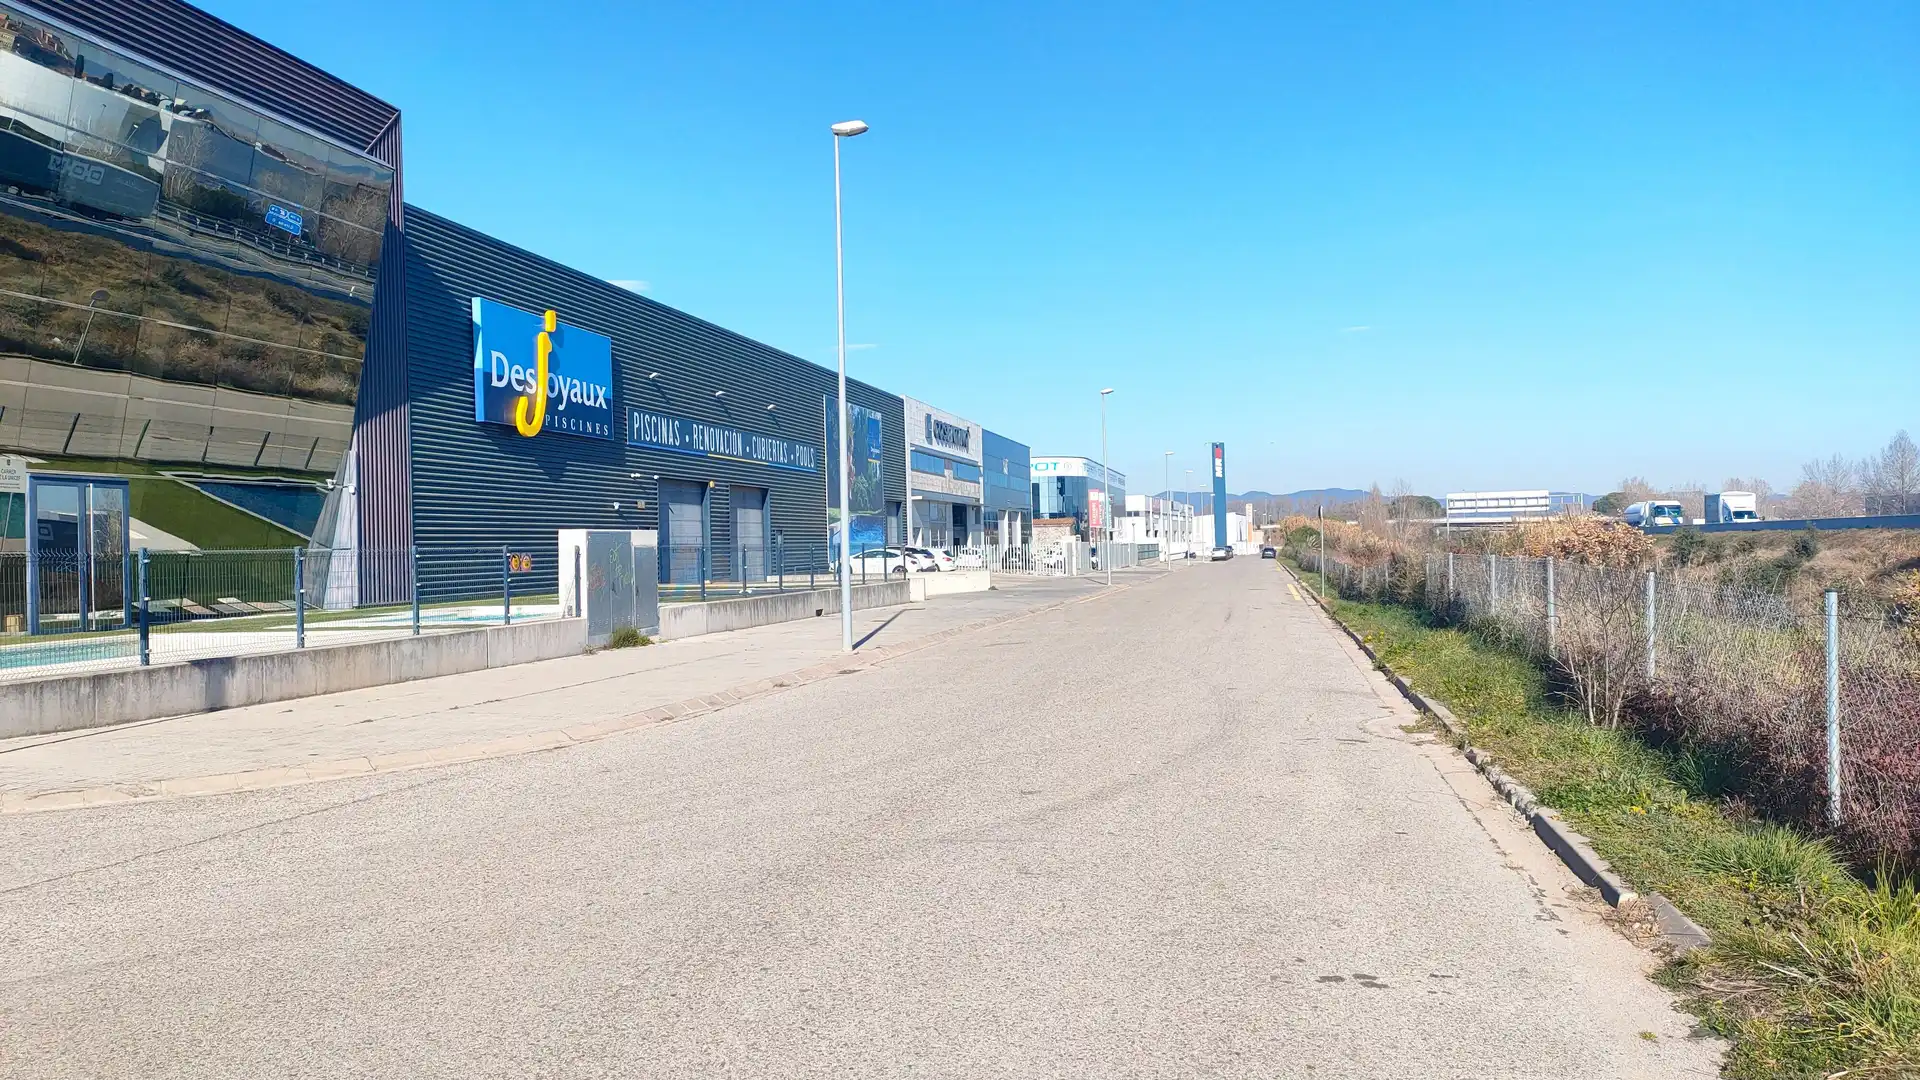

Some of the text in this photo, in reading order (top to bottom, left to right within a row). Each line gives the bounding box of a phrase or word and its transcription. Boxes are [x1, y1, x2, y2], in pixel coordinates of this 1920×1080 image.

[545, 414, 609, 436] PISCINES
[633, 412, 815, 468] PISCINAS RENOVACIÓN CUBIERTAS POOLS
